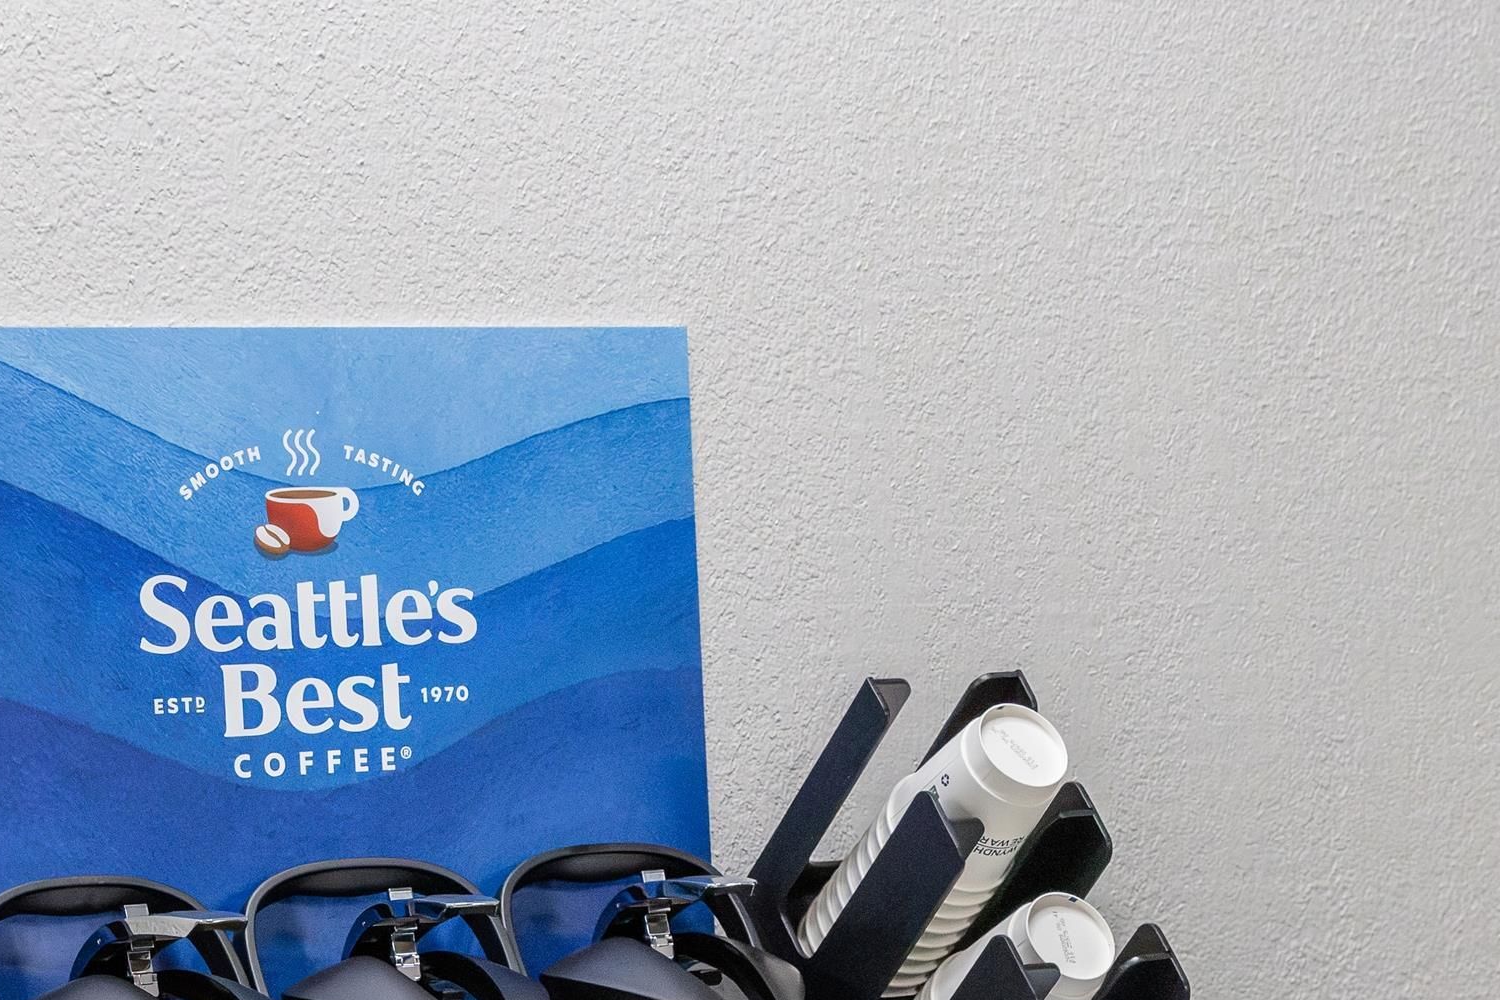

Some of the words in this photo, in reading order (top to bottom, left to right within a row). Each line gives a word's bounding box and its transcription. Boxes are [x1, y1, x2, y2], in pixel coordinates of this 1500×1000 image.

[178, 445, 262, 501] SMOOTH
[343, 444, 426, 497] TASTING
[138, 573, 478, 655] Seattle's
[220, 662, 413, 738] Best
[420, 685, 470, 703] 1970
